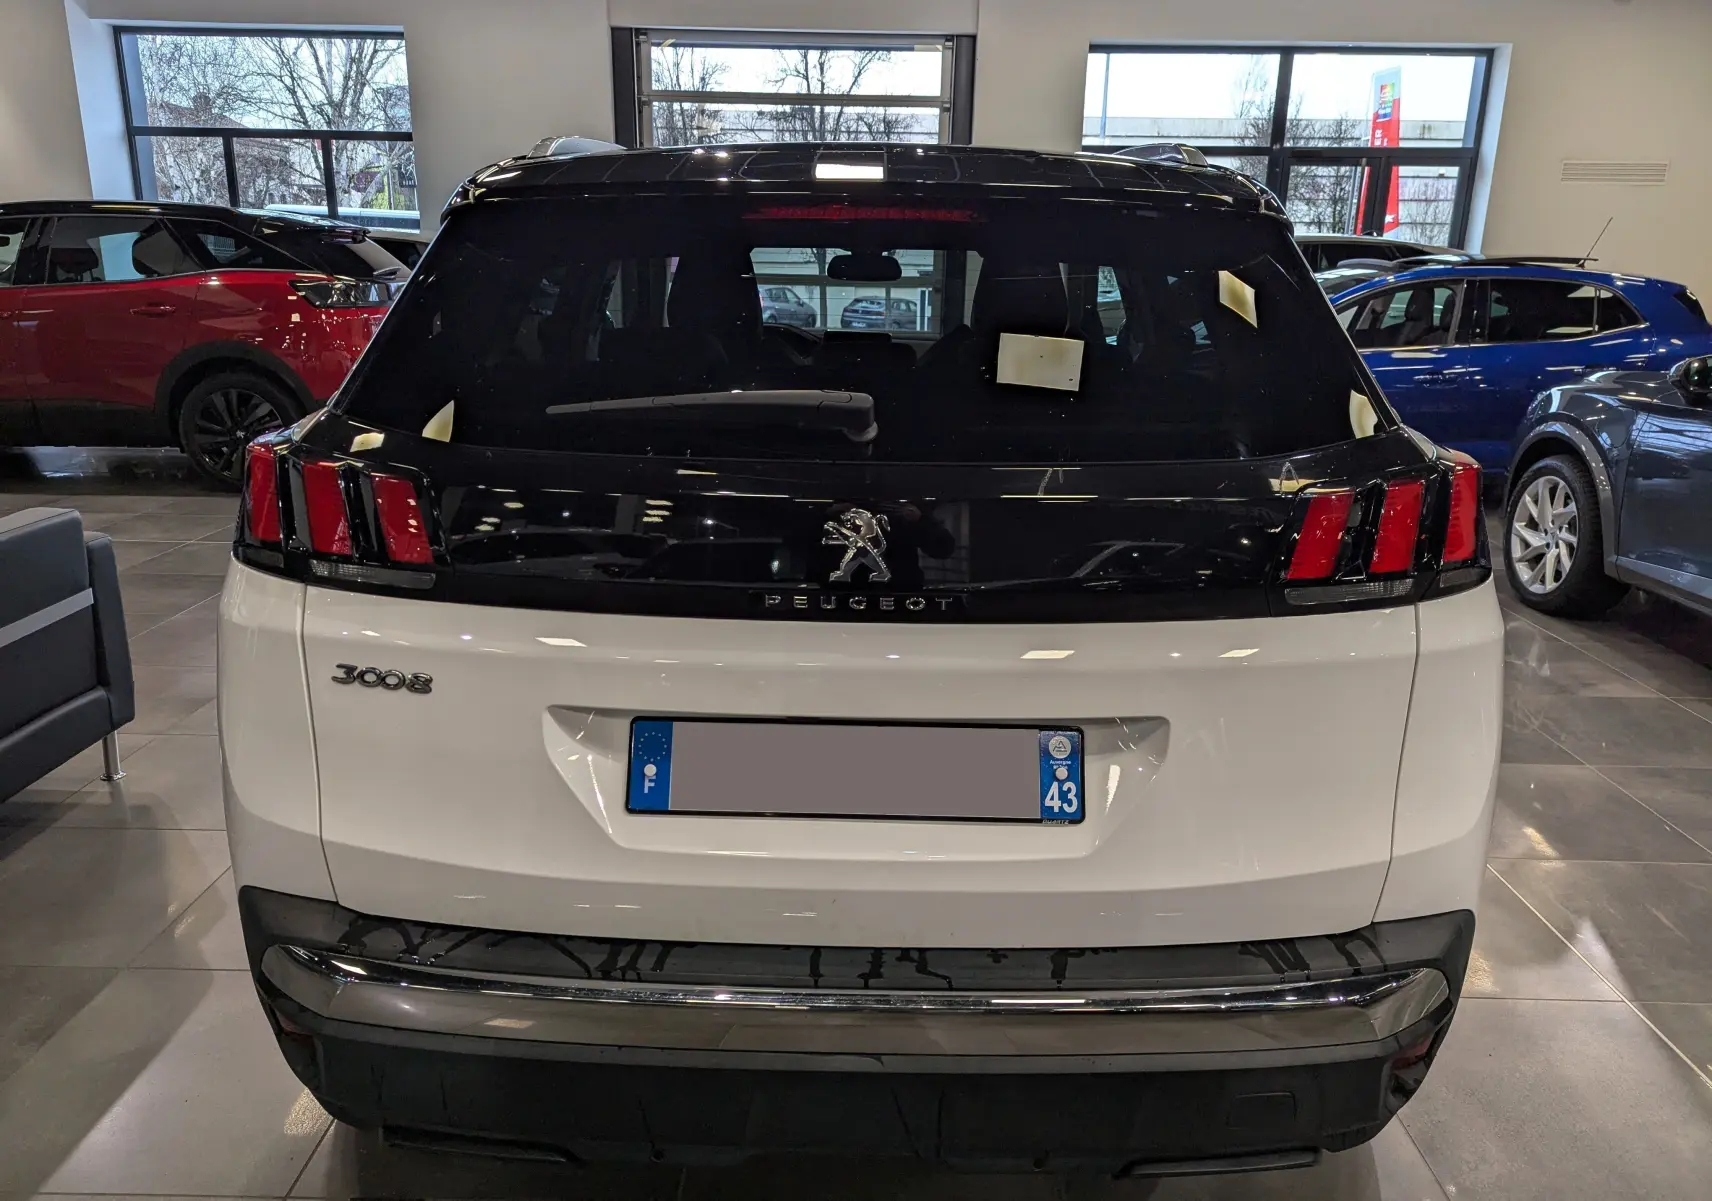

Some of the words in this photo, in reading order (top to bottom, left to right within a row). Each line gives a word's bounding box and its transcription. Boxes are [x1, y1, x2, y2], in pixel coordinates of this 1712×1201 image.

[765, 594, 952, 611] PEUGEOT
[331, 663, 433, 694] 3008
[643, 775, 657, 794] F
[1044, 781, 1078, 813] 43
